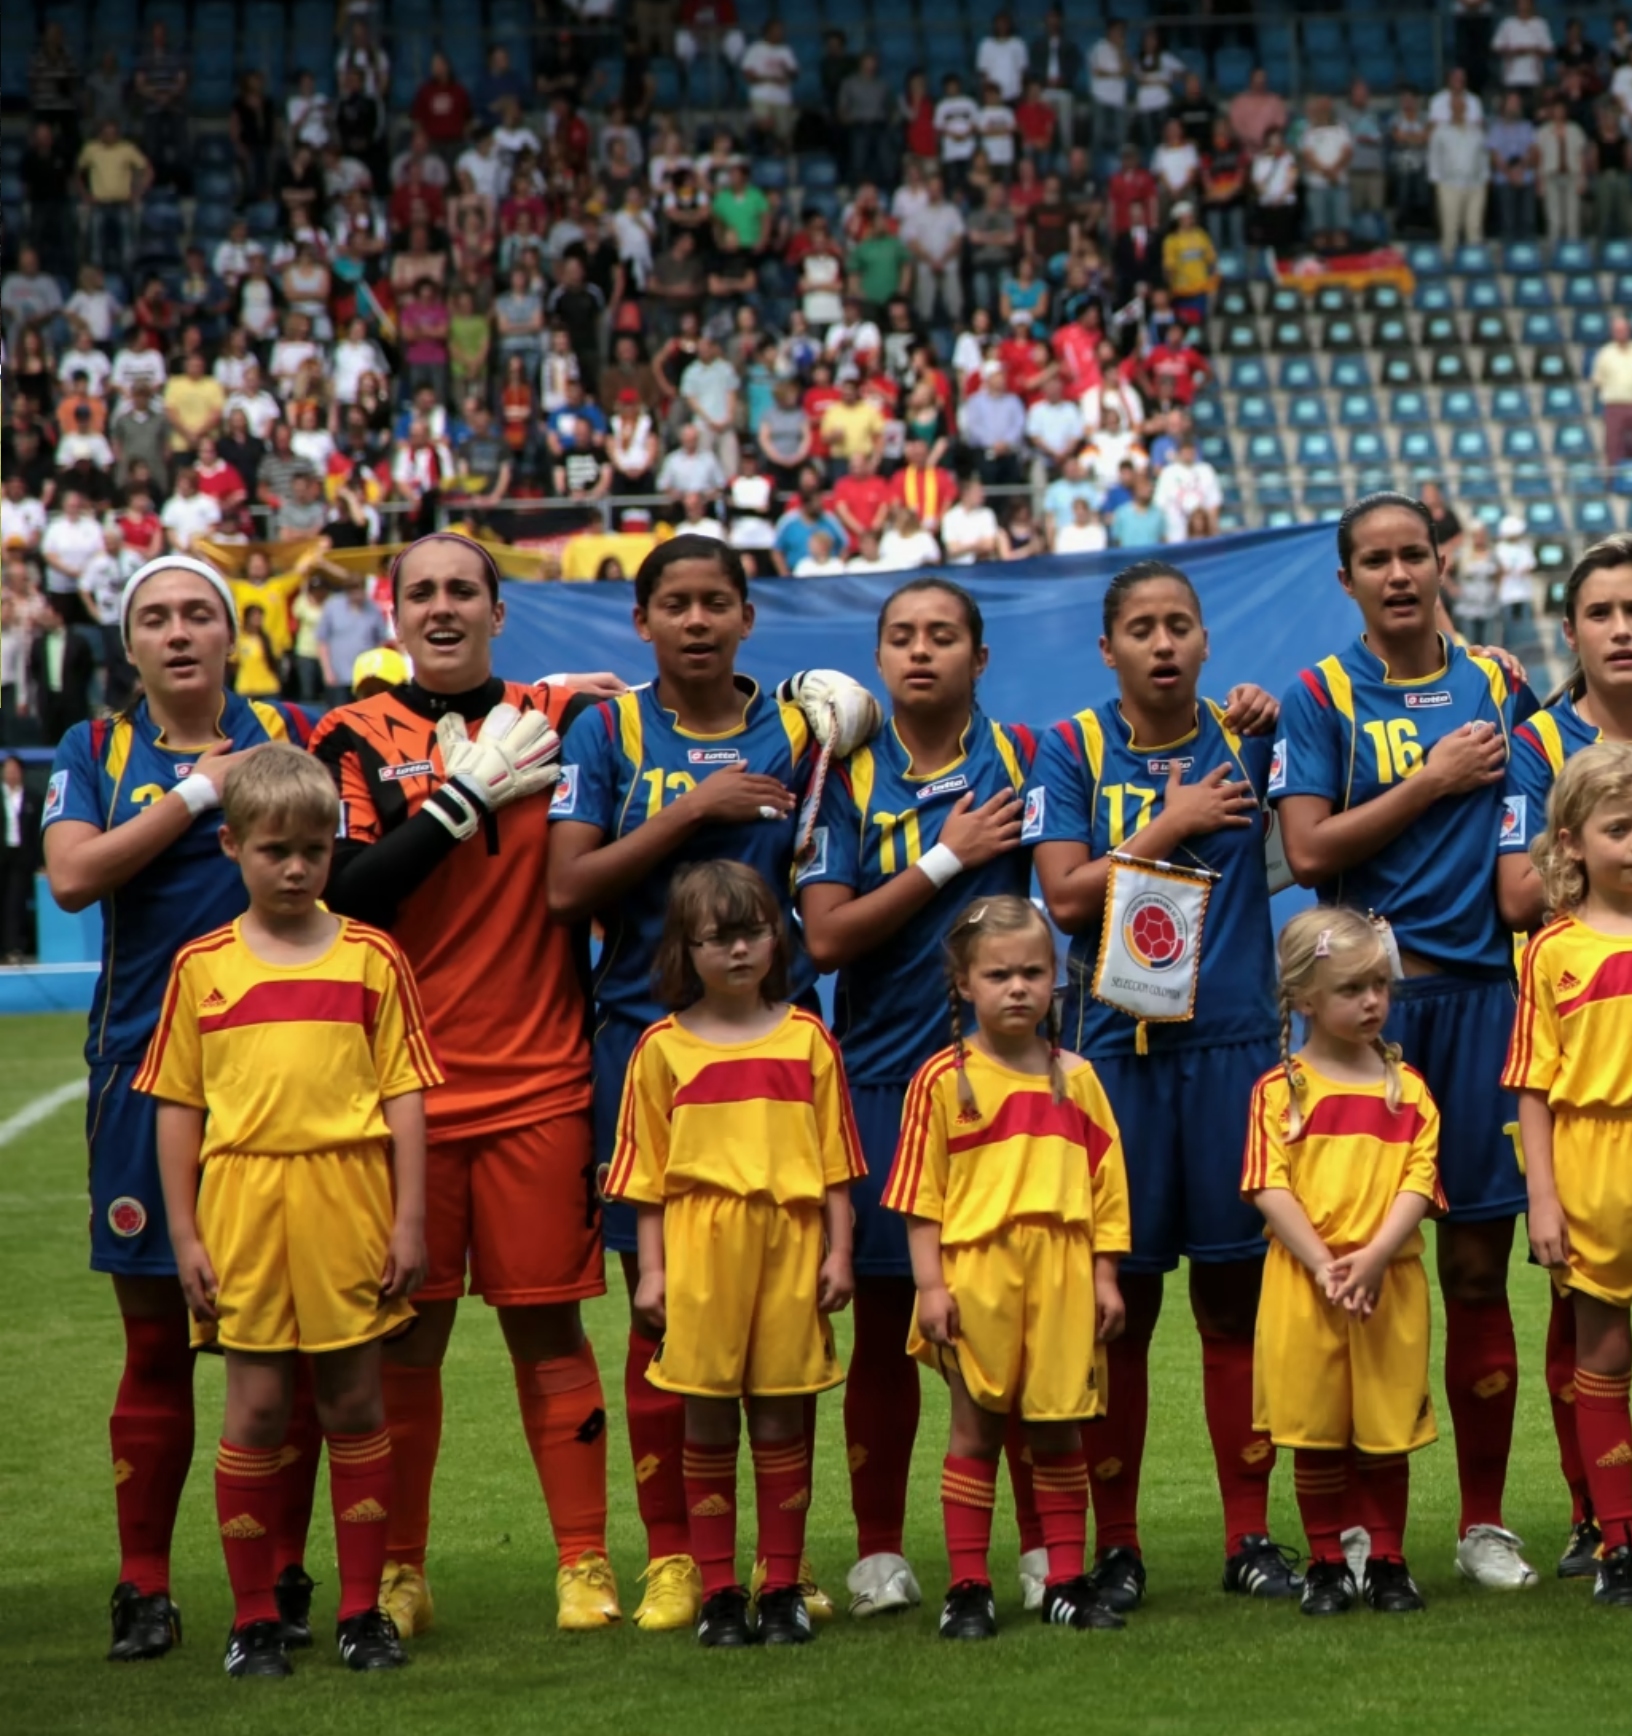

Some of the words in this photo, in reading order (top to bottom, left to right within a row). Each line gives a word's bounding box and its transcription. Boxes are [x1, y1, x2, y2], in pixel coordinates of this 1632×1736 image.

[1418, 694, 1449, 704] lotto
[704, 750, 737, 760] lotto
[1362, 717, 1426, 783] 16
[396, 763, 432, 776] lotto
[932, 779, 964, 792] lotto
[1101, 783, 1156, 847] 17
[873, 808, 923, 875] 11
